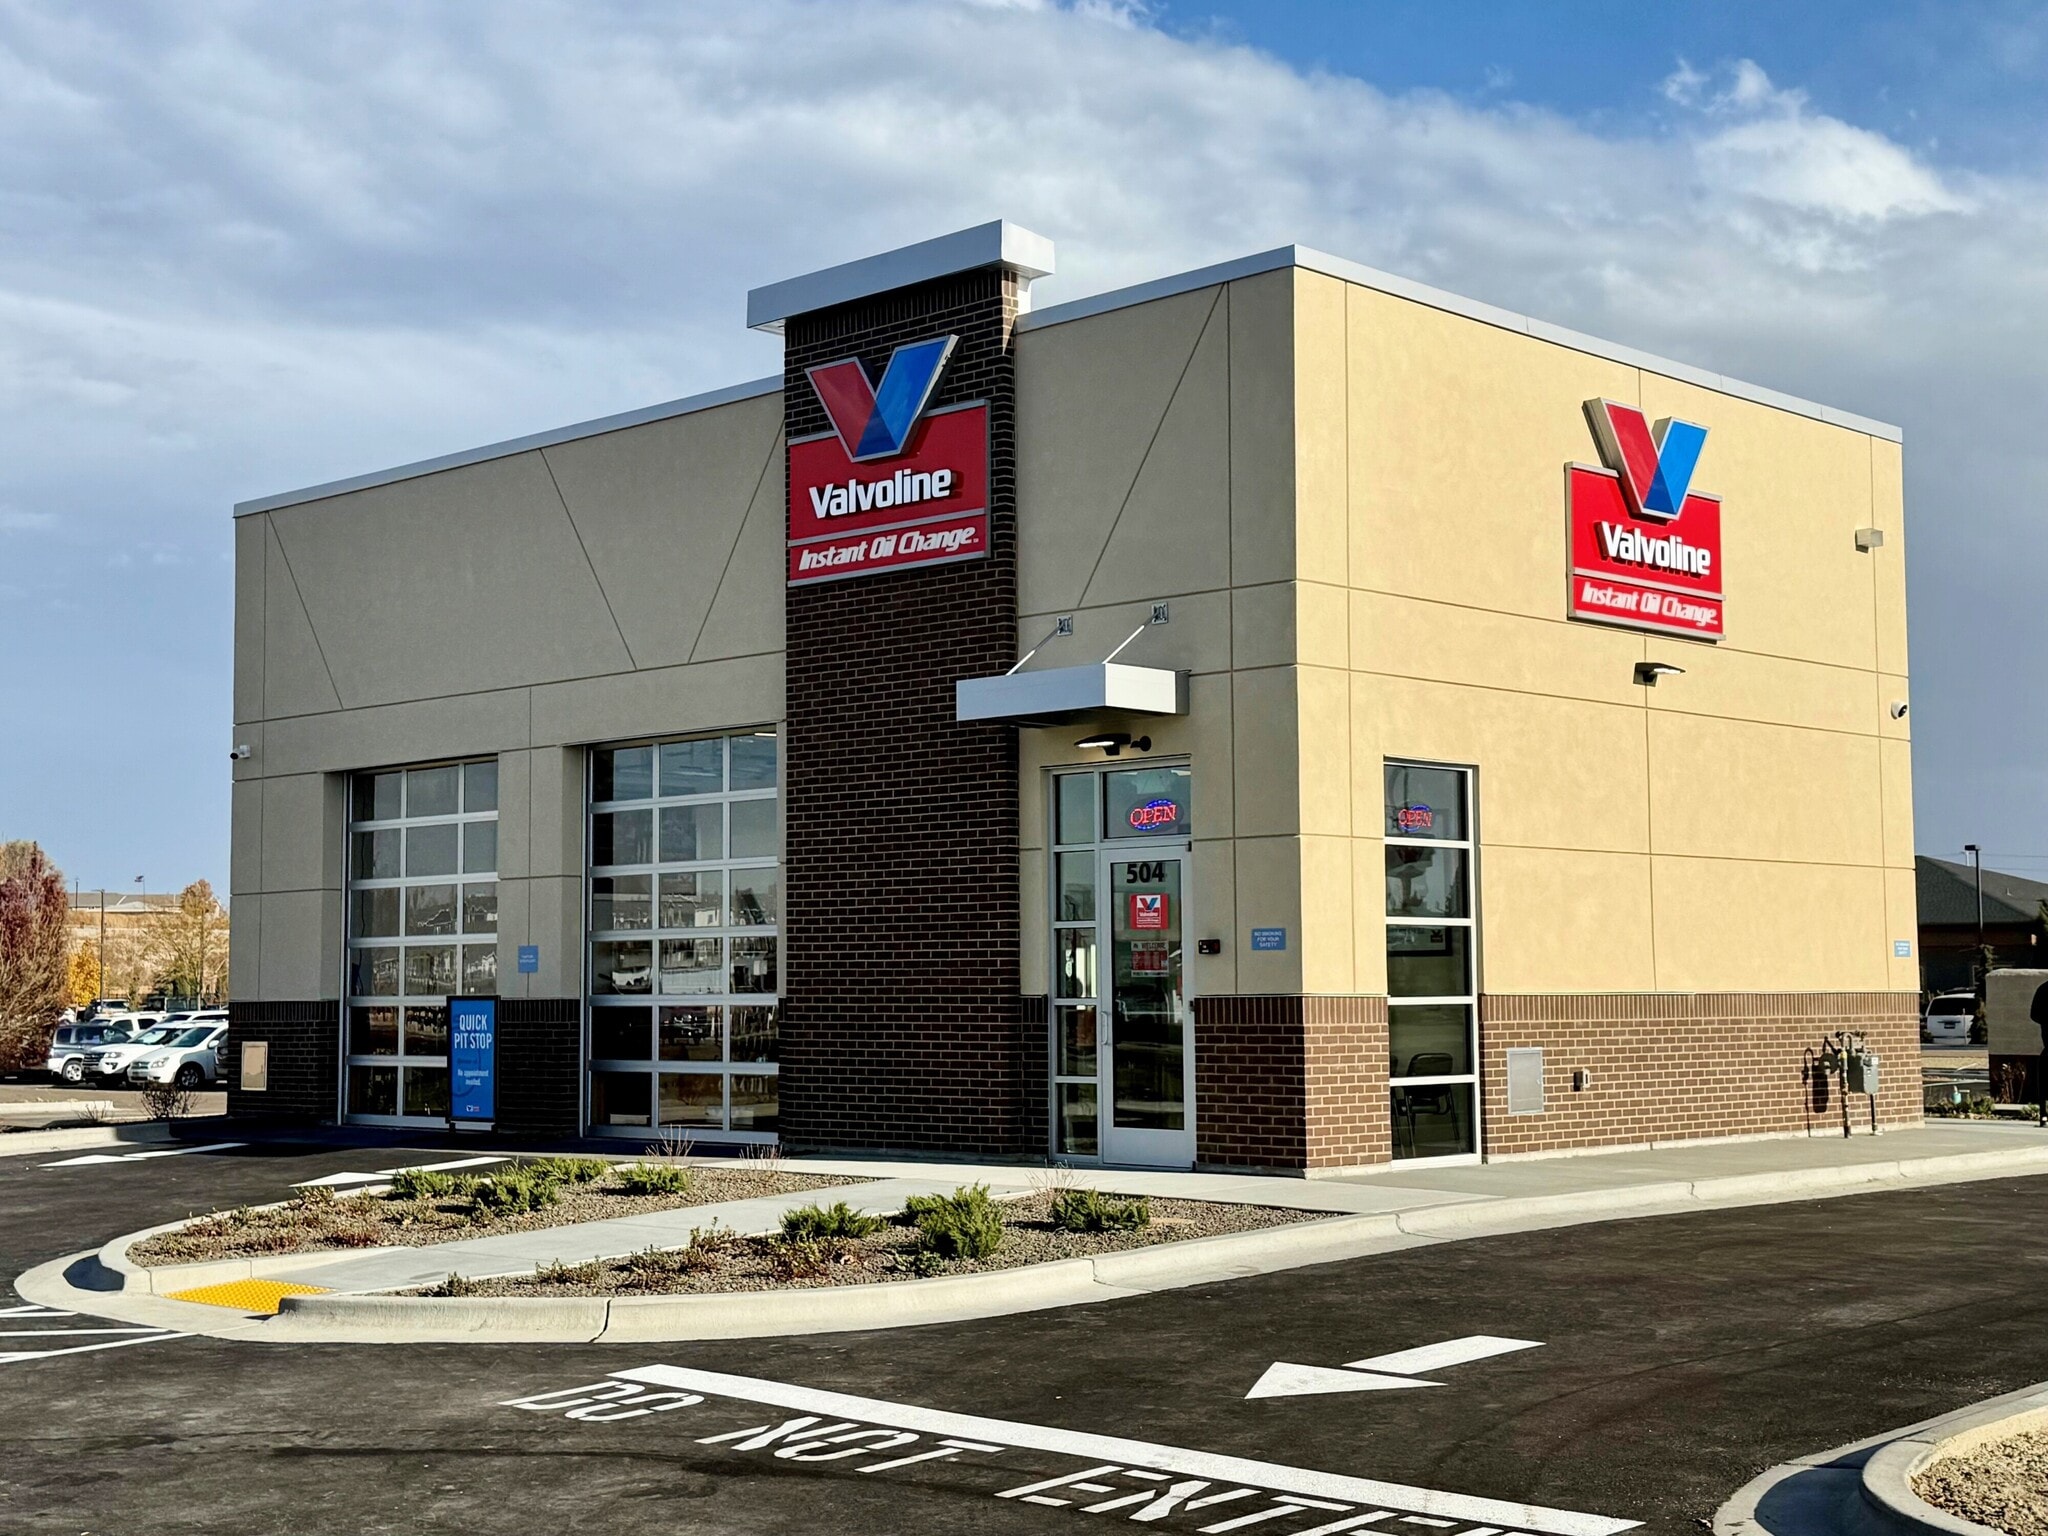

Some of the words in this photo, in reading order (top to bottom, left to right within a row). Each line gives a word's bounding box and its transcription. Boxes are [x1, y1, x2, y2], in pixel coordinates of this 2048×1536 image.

[809, 468, 952, 519] Valvoline
[798, 541, 868, 571] Instant
[869, 534, 897, 559] Oil
[1601, 521, 1711, 575] Valvoline
[1581, 581, 1639, 611] Instant
[1640, 592, 1661, 615] Oil
[1130, 805, 1177, 826] OPEN
[1398, 808, 1433, 827] OPEN
[1126, 863, 1164, 883] 504
[459, 1014, 488, 1031] QUICK
[454, 1033, 468, 1049] PIT
[470, 1033, 492, 1049] STOP
[500, 1380, 704, 1421] DO
[694, 1416, 1005, 1473] NOT
